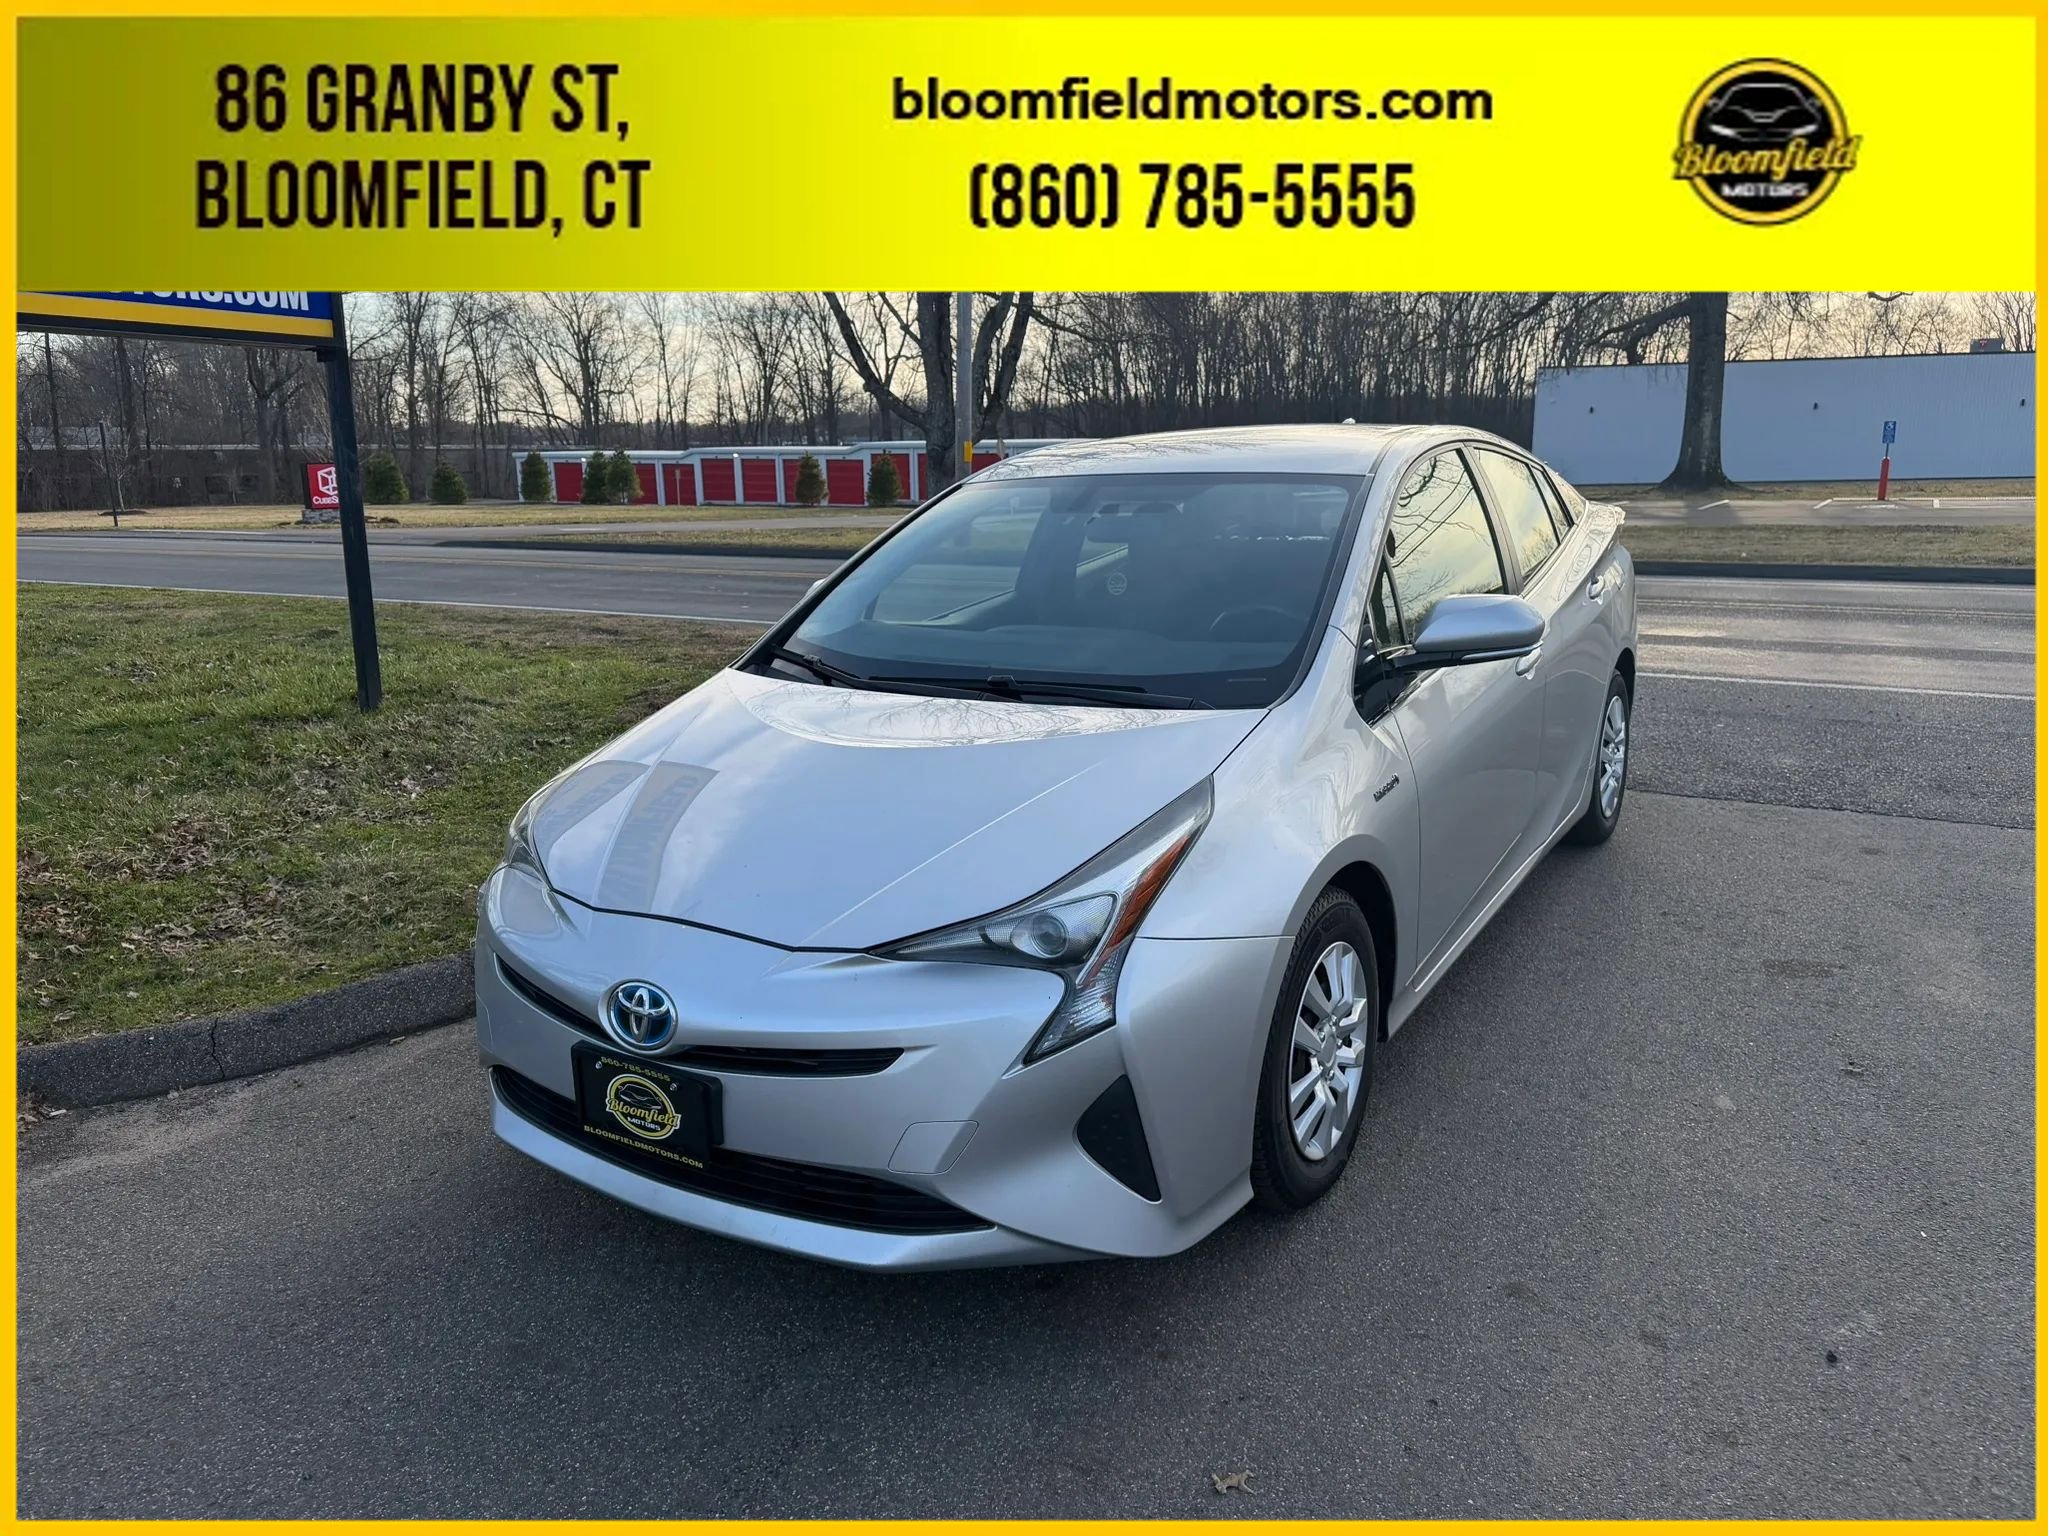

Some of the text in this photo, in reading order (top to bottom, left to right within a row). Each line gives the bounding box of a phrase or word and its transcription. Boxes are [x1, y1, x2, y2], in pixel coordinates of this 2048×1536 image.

[608, 1099, 679, 1126] Bloomfield
[627, 1116, 661, 1131] MOTORS
[583, 1125, 704, 1168] BLOOMFIELDMOTORS.COM
